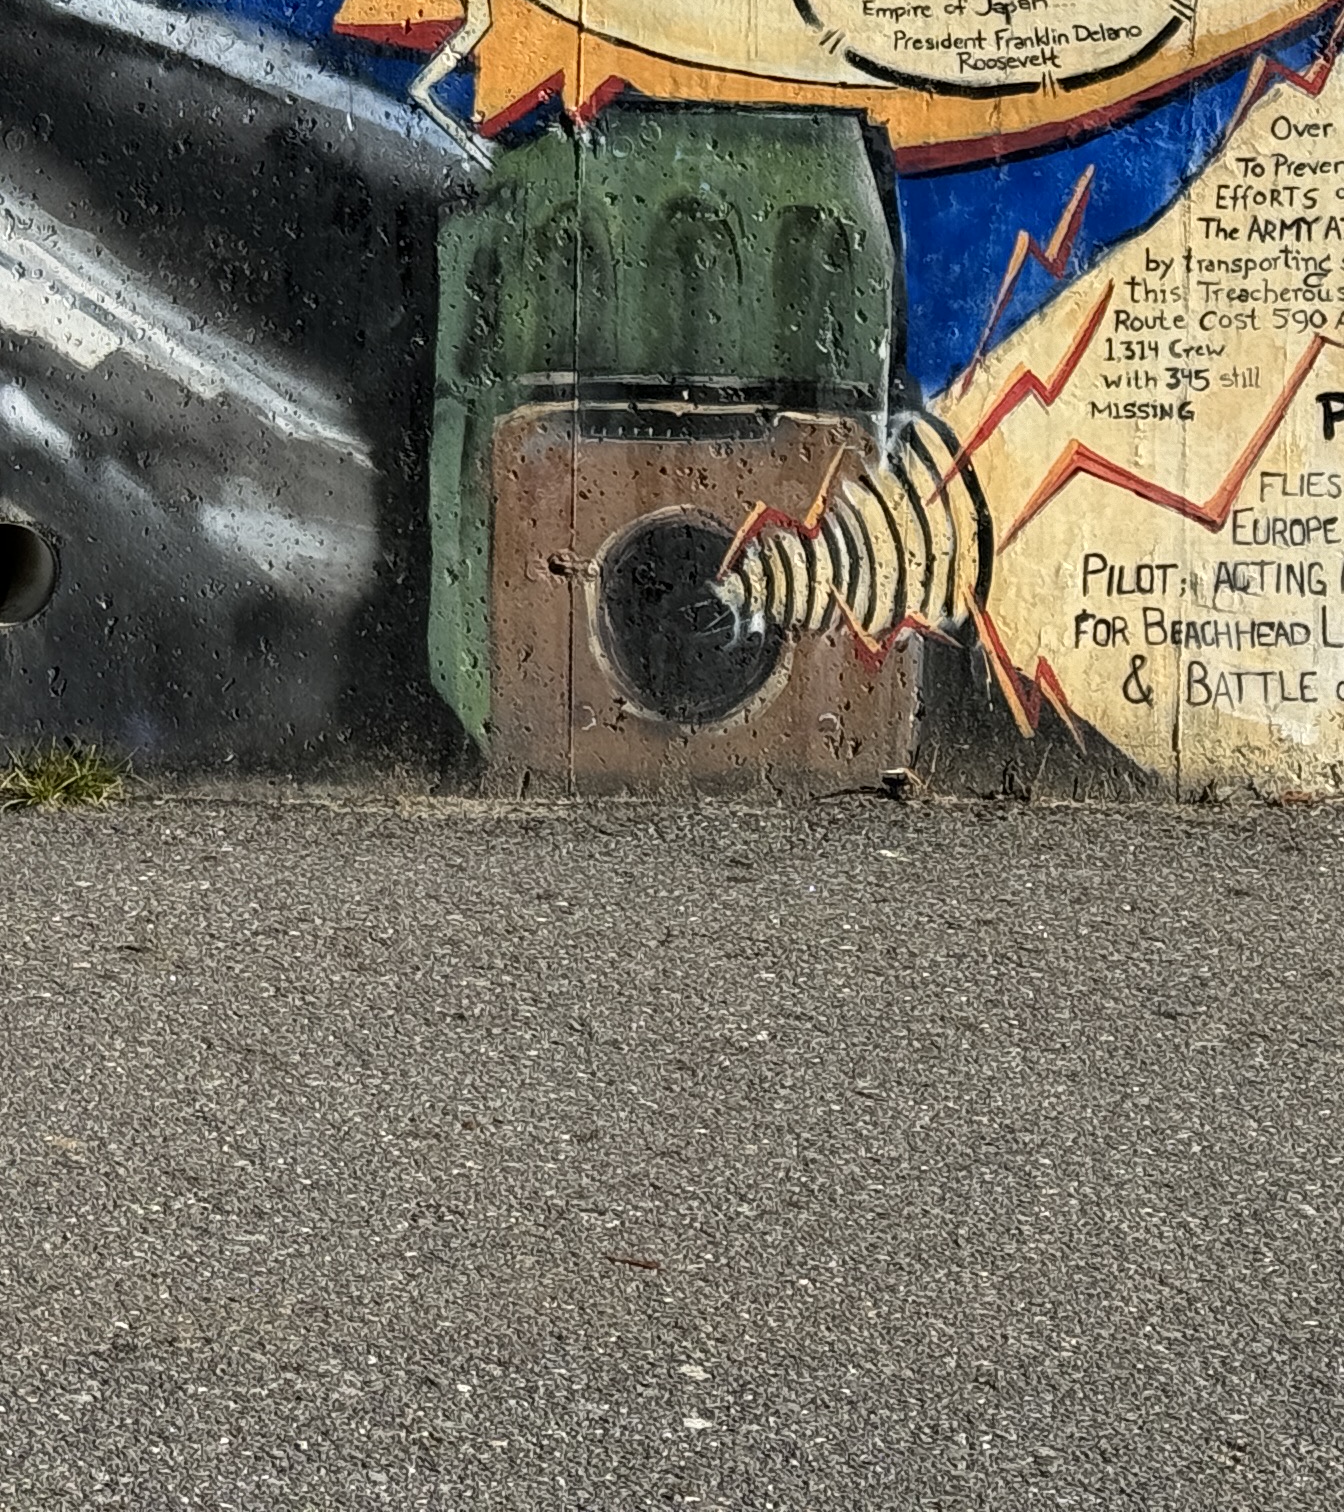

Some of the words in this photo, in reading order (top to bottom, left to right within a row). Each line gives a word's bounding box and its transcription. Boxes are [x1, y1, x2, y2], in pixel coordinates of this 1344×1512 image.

[863, 0, 931, 23] Empire
[894, 30, 986, 51] President
[994, 27, 1070, 52] Franklin
[1074, 24, 1142, 43] Delano
[956, 49, 1062, 74] Roosevelt
[1271, 115, 1333, 140] Over
[1235, 157, 1265, 178] To
[1197, 217, 1240, 241] The
[1247, 215, 1323, 243] ARMY
[1146, 247, 1173, 278] by
[1183, 245, 1333, 288] transporting
[1124, 276, 1182, 303] this
[1114, 309, 1186, 333] Route
[1272, 308, 1328, 334] 590
[1168, 338, 1225, 361] Crew
[1100, 369, 1158, 389] with
[1165, 367, 1210, 391] 345
[1219, 366, 1260, 388] still
[1260, 471, 1342, 502] FLIES
[1232, 507, 1342, 547] EUROPE
[1213, 560, 1327, 597] ACTING
[1074, 609, 1130, 650] FOR
[1143, 606, 1311, 651] BEACHHEAD
[1122, 654, 1154, 708] &
[1186, 659, 1318, 709] BATTLE
